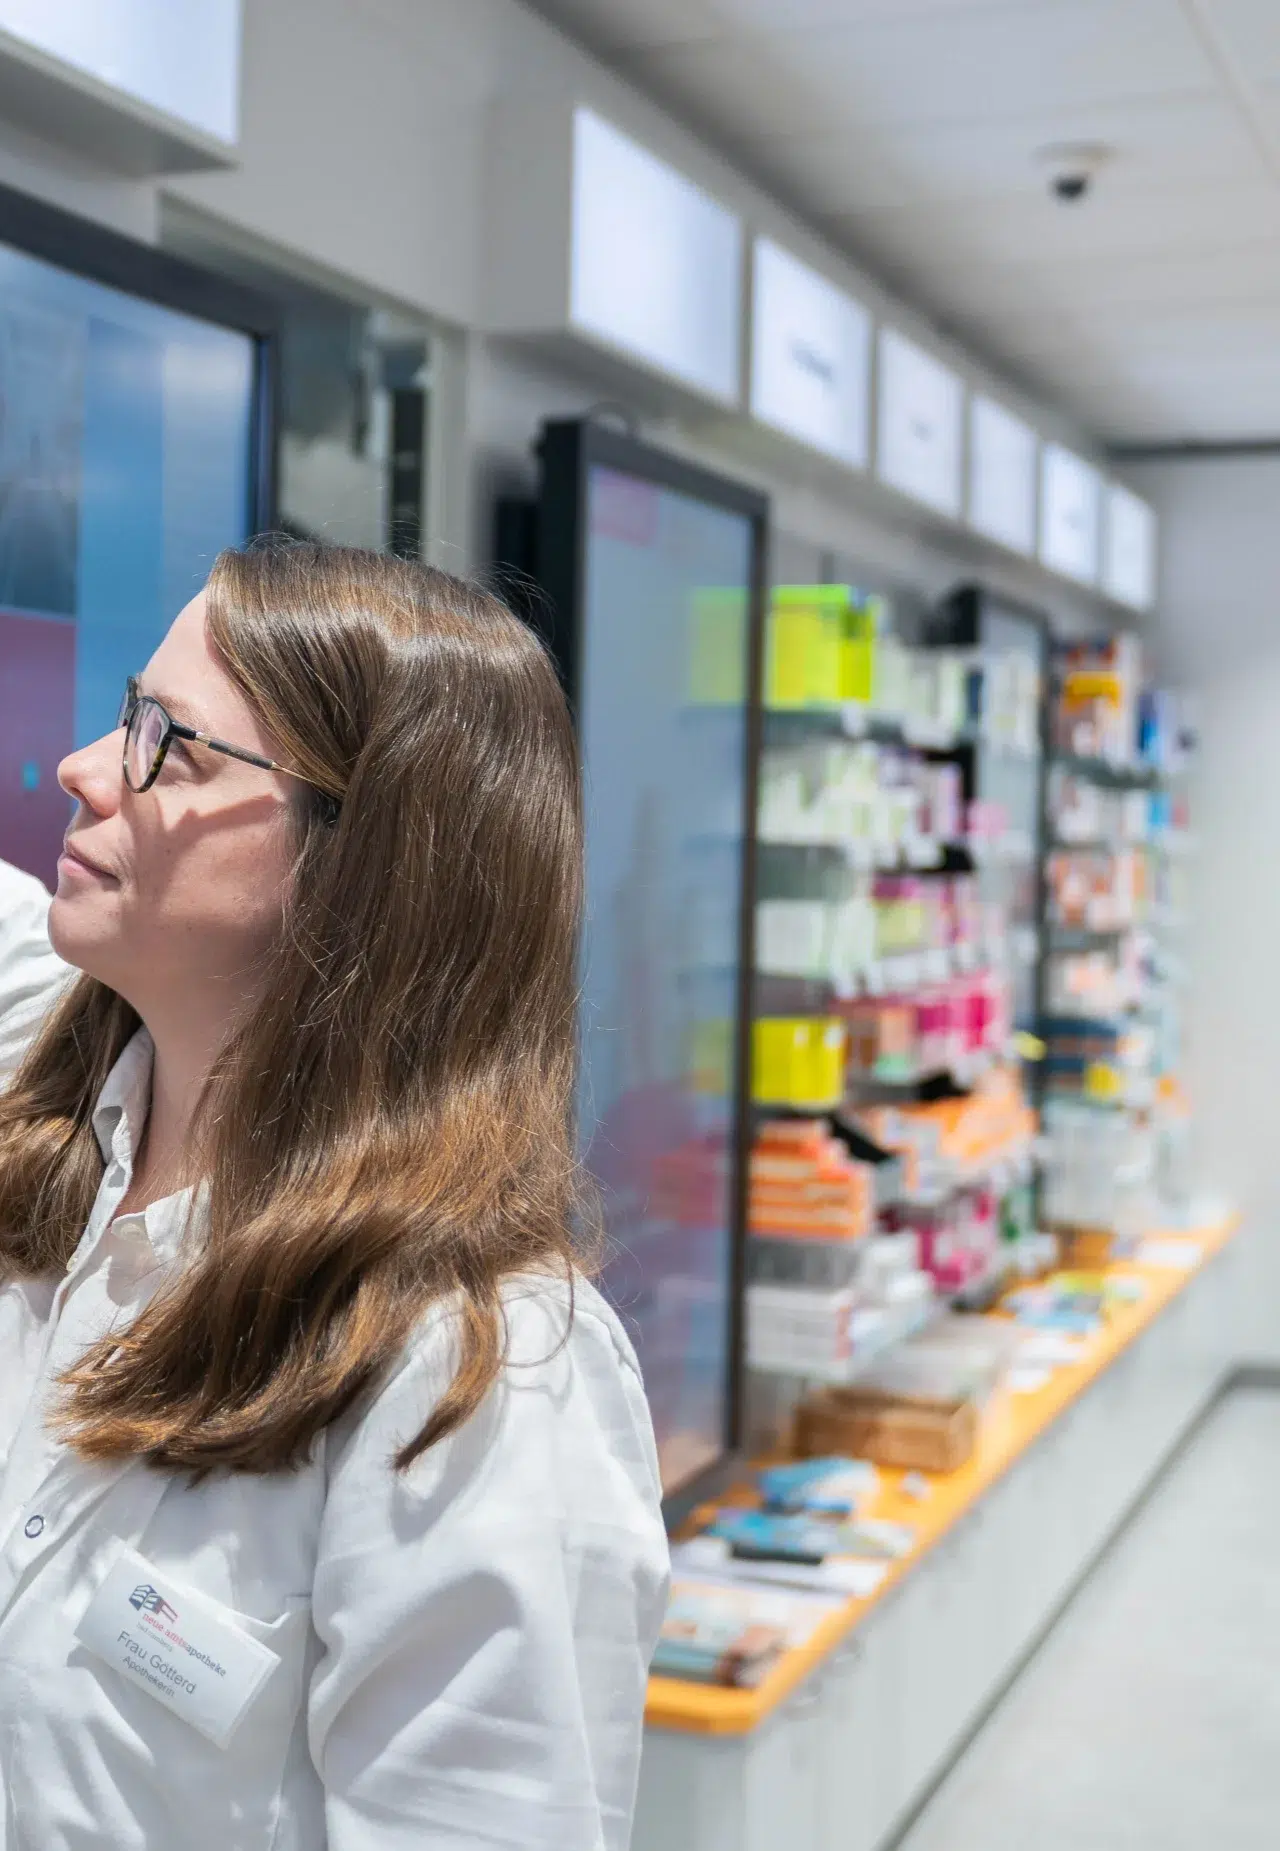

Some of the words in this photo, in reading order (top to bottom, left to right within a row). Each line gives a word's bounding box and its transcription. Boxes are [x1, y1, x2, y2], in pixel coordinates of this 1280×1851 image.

[142, 1613, 164, 1632] neue
[117, 1630, 148, 1659] Frau
[149, 1653, 197, 1694] Götterd
[122, 1655, 175, 1698] Apothekerin
